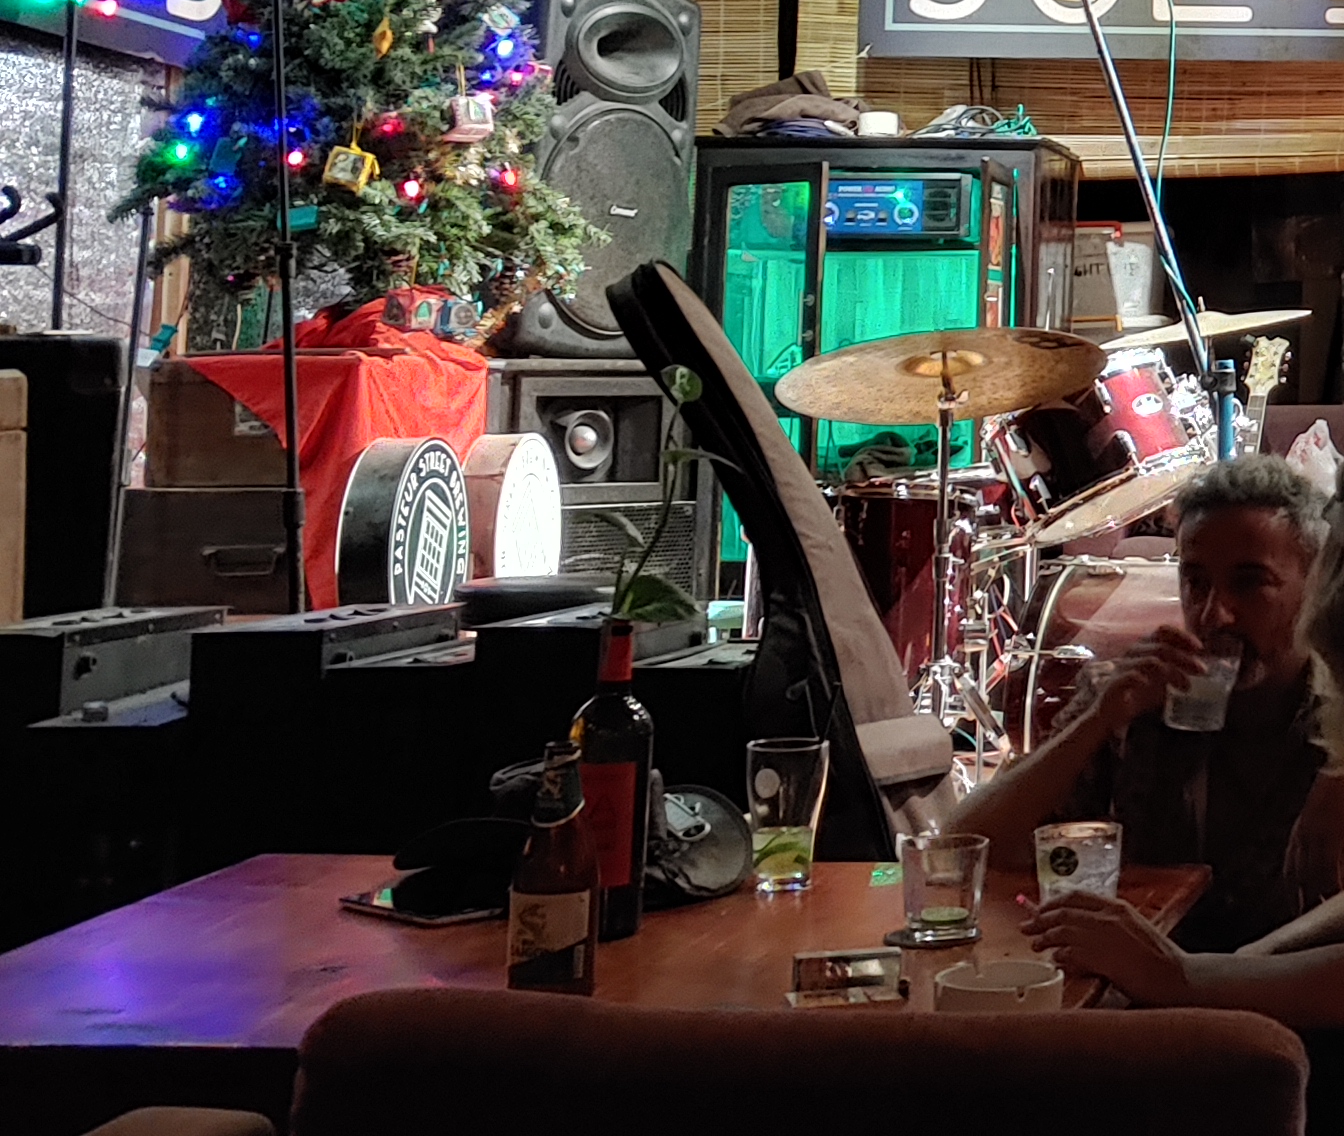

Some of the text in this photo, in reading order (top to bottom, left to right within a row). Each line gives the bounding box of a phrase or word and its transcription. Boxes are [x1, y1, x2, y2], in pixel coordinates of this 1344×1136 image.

[394, 450, 469, 576] PASTEUR STREET BREWING
